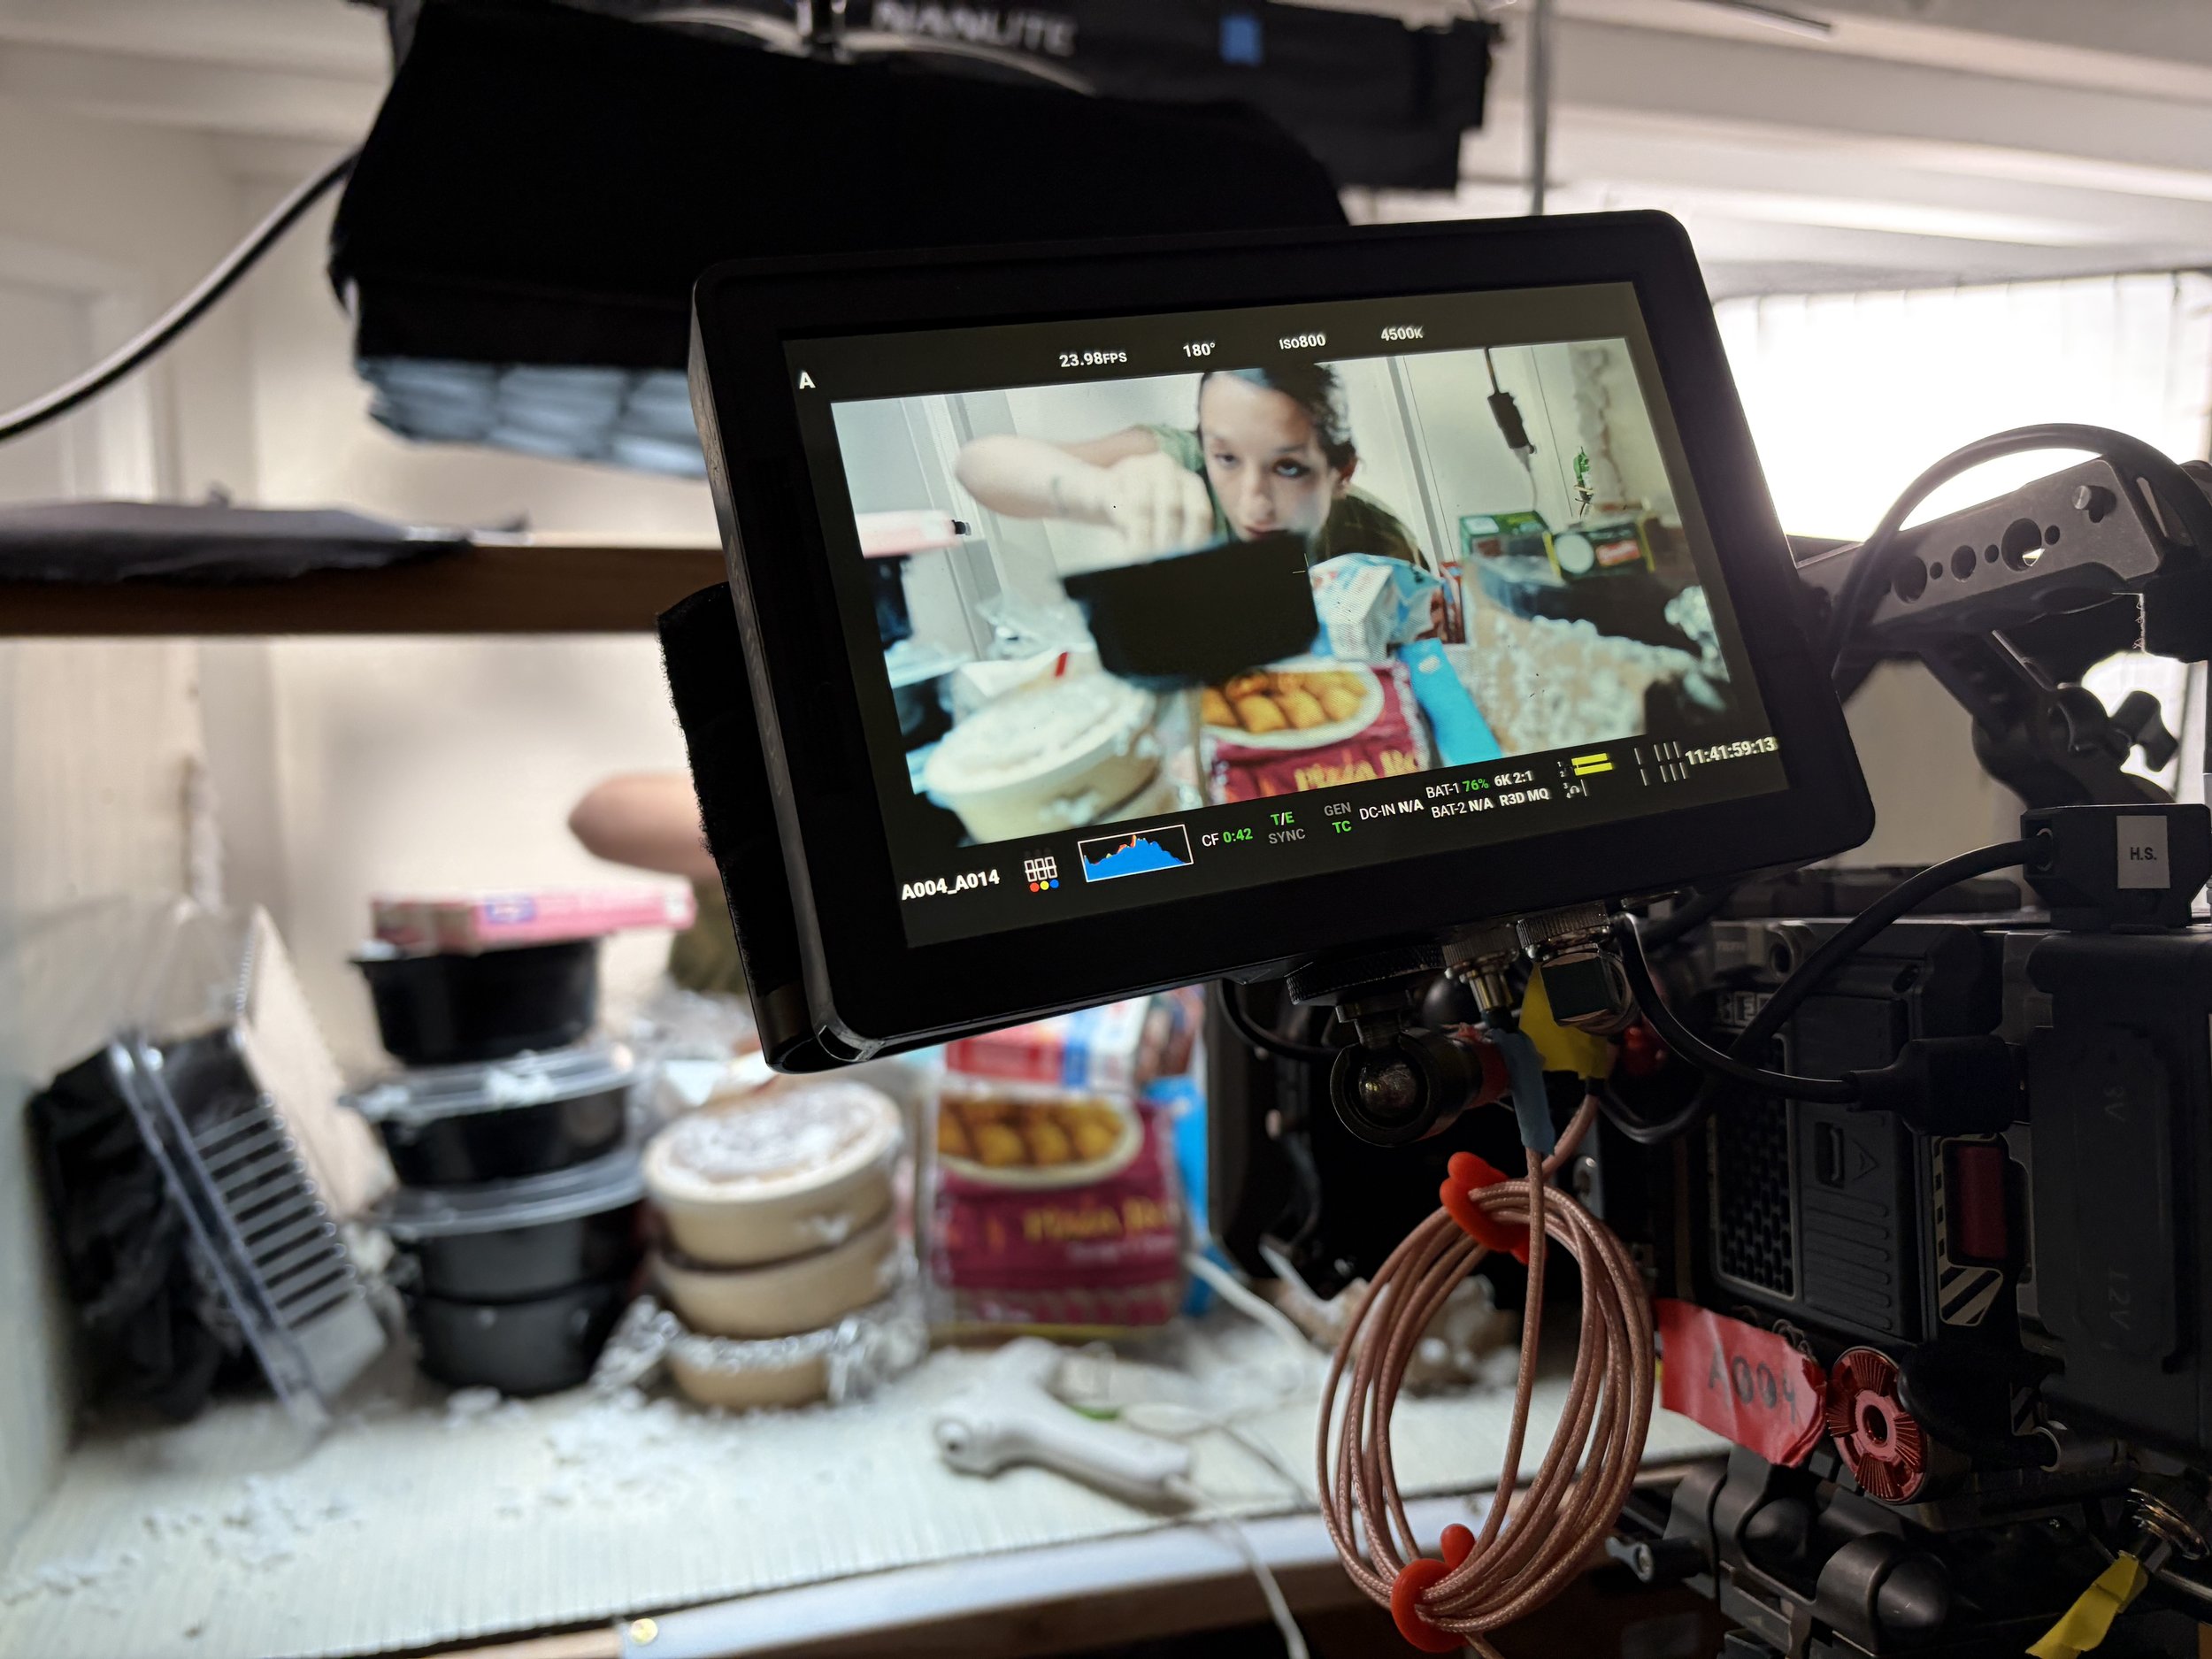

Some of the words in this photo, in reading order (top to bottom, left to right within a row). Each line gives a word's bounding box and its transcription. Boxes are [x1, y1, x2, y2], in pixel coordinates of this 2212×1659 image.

[1380, 326, 1424, 342] 4500K
[1059, 351, 1127, 367] 23.98FPS
[799, 370, 816, 389] A
[1685, 736, 1779, 765] 11:41:59:13
[1494, 773, 1512, 787] 6K
[1512, 770, 1534, 784] 2:1
[1425, 782, 1460, 799] BAT-1
[1462, 778, 1489, 793] 76%
[1499, 791, 1525, 806] R3D
[1527, 787, 1550, 803] MQ
[1324, 802, 1352, 817] GEN
[1359, 803, 1395, 820] DC-IN
[1397, 798, 1425, 814] N/A
[1431, 802, 1466, 818] BAT-2
[1468, 796, 1494, 812] N/A
[1271, 811, 1294, 826] T/E
[1332, 820, 1352, 833] TC
[1202, 833, 1219, 847] CF
[1223, 827, 1254, 843] 0:42
[1268, 828, 1306, 844] SYNC
[2130, 847, 2157, 861] H.S.
[902, 869, 1001, 901] A004_A014
